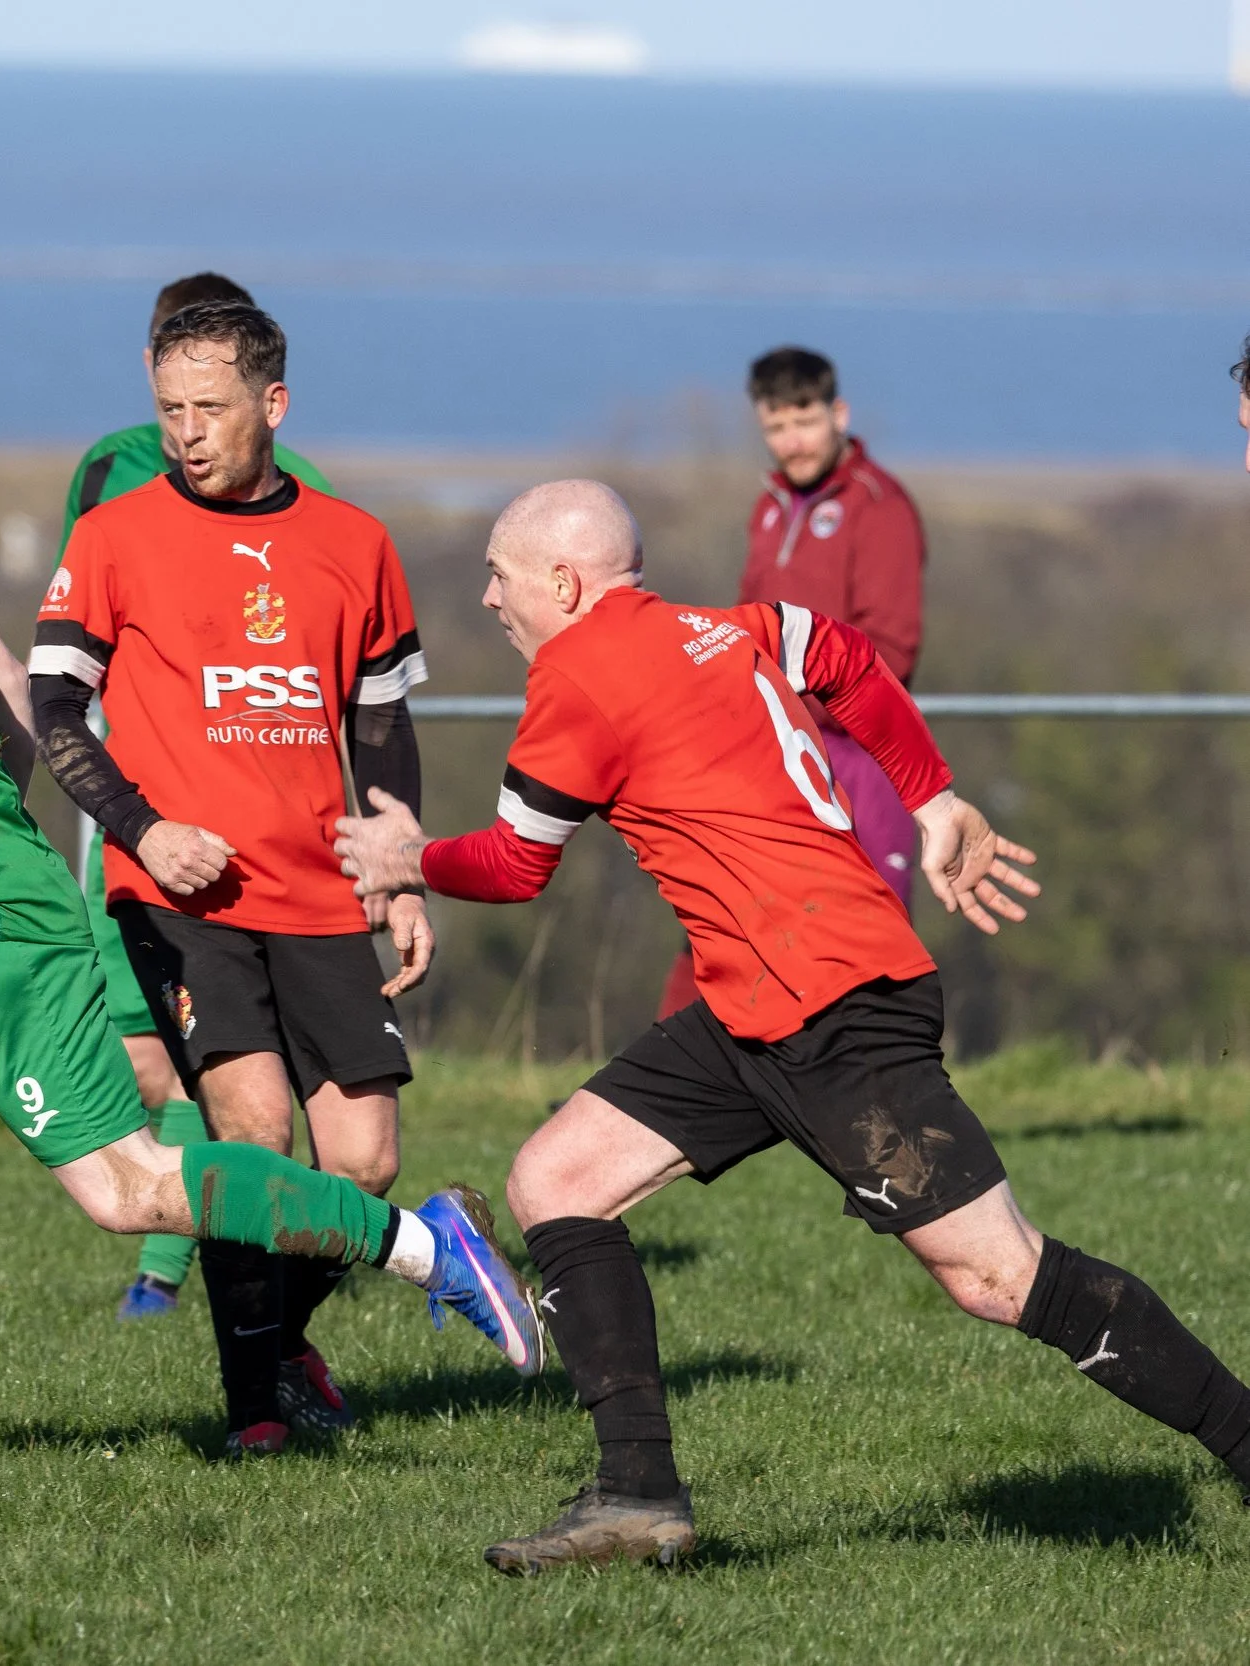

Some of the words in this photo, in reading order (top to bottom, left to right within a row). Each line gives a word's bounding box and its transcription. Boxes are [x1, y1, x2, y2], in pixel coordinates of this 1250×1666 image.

[682, 640, 703, 656] RG
[693, 642, 729, 666] cleaning
[202, 665, 325, 709] PSS
[206, 726, 255, 744] AUTO
[257, 727, 329, 745] CENTRE
[753, 671, 853, 831] 6
[15, 1076, 45, 1114] 9
